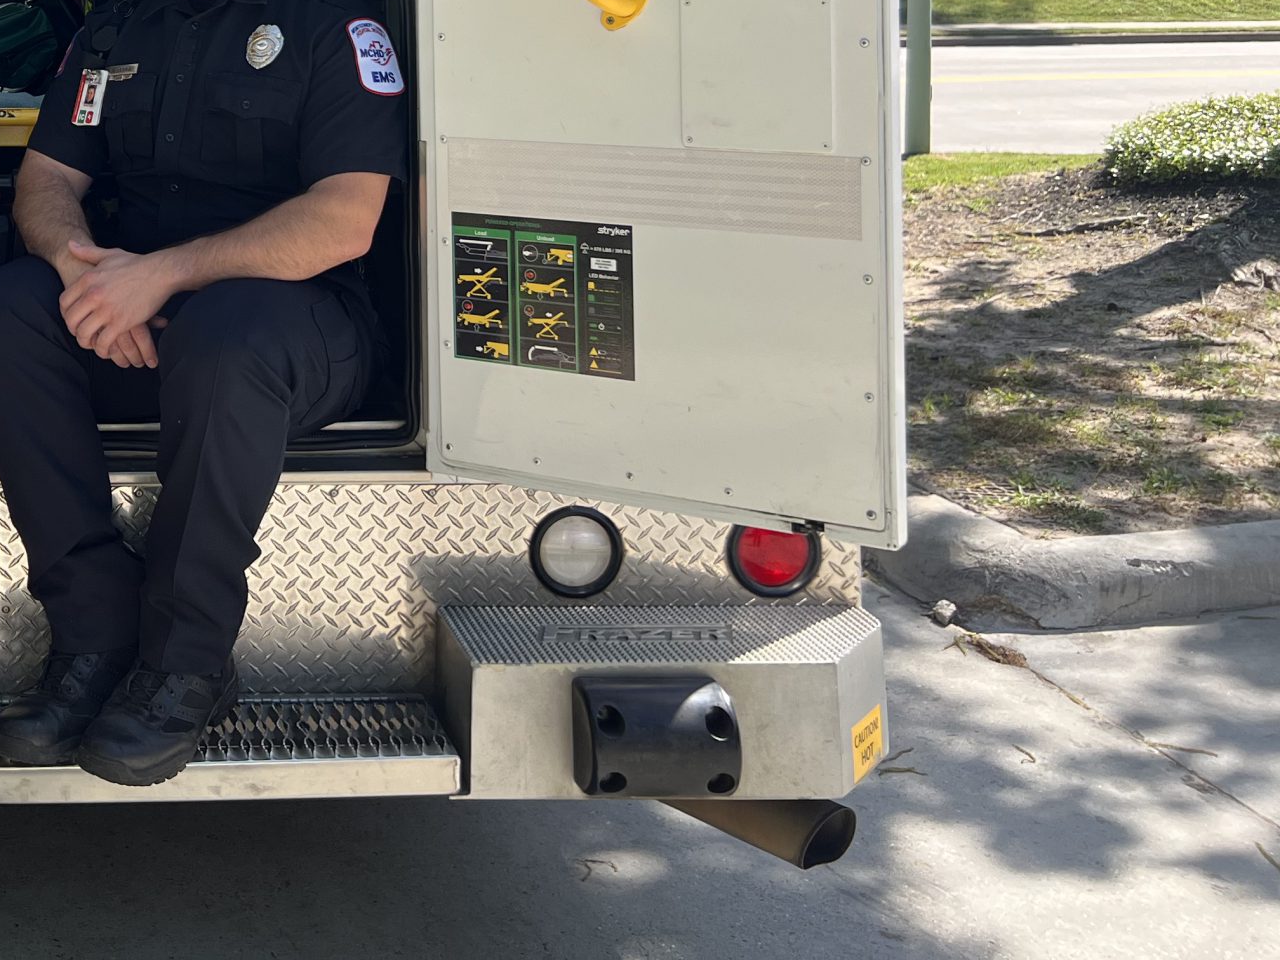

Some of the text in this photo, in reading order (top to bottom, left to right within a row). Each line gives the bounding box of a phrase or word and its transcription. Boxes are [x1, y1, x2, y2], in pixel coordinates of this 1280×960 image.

[359, 48, 385, 58] MCHD
[370, 71, 396, 84] EMS
[597, 225, 630, 237] stryker
[542, 624, 728, 642] FRAZER
[853, 716, 879, 749] CAUTION!
[860, 741, 875, 765] HOT
